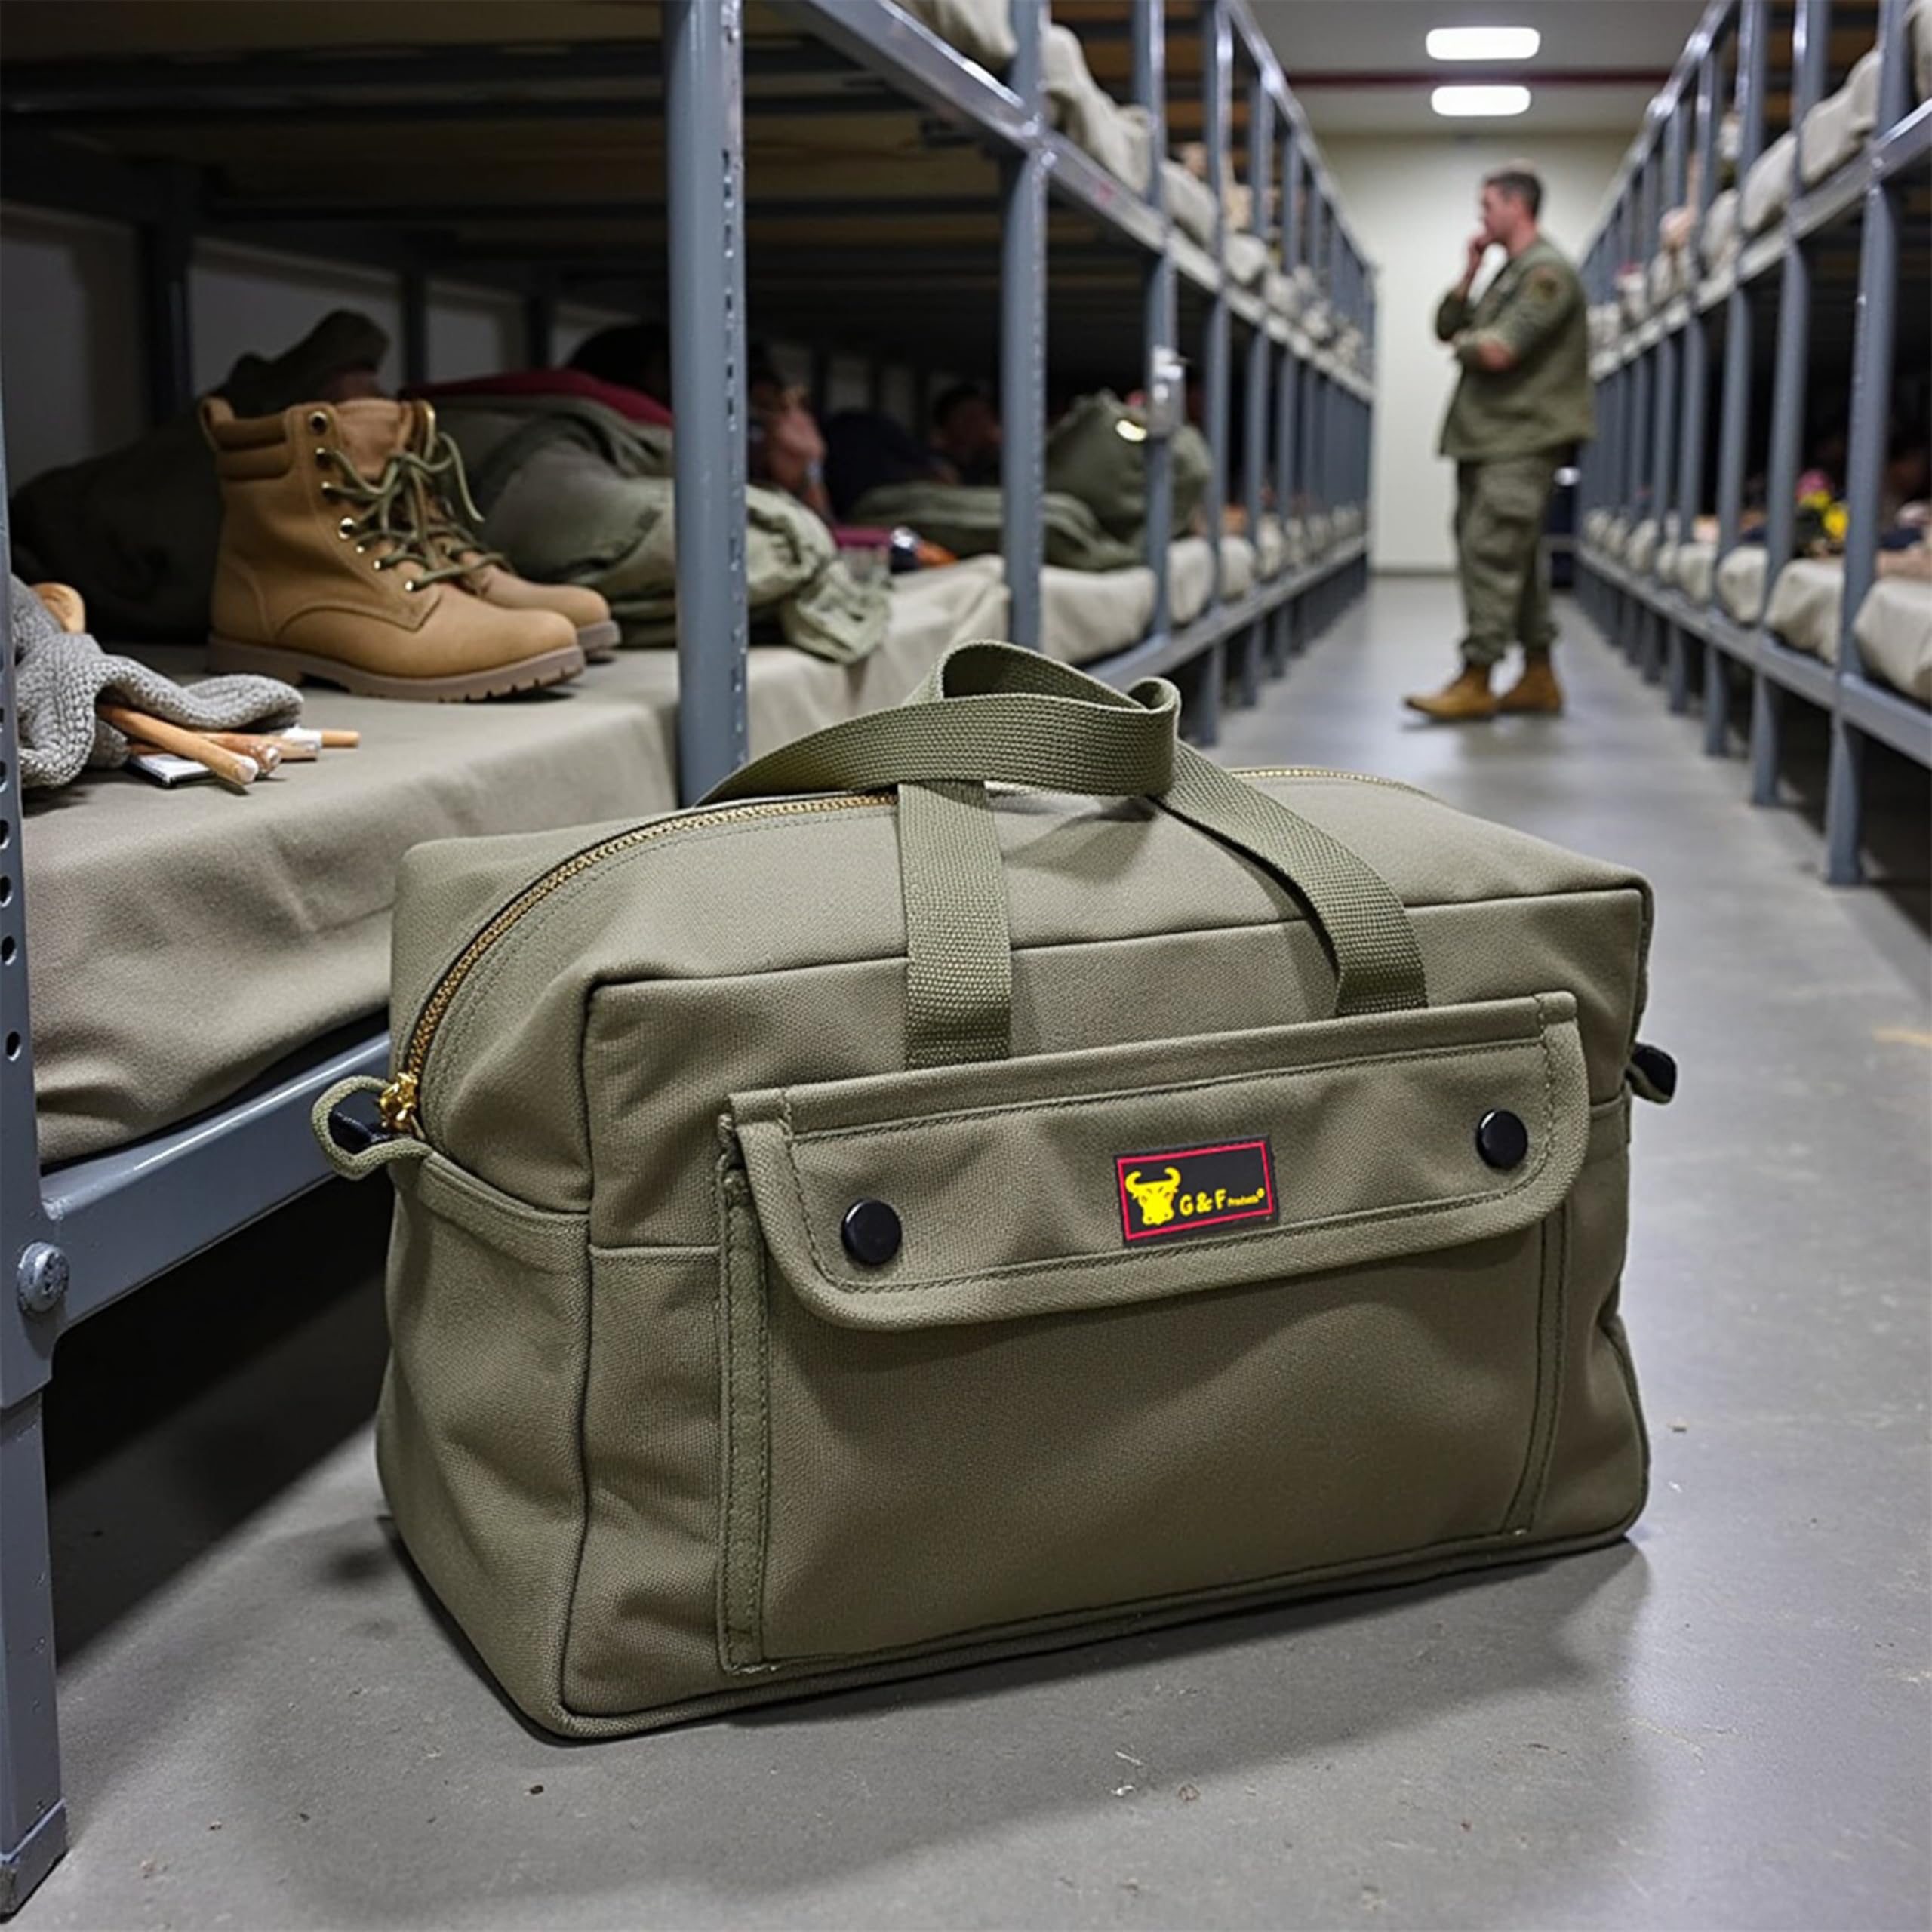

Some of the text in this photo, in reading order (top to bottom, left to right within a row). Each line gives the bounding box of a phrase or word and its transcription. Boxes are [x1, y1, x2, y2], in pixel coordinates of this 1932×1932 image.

[1179, 1194, 1194, 1216] G
[1197, 1192, 1213, 1213] &
[1214, 1189, 1226, 1210] F
